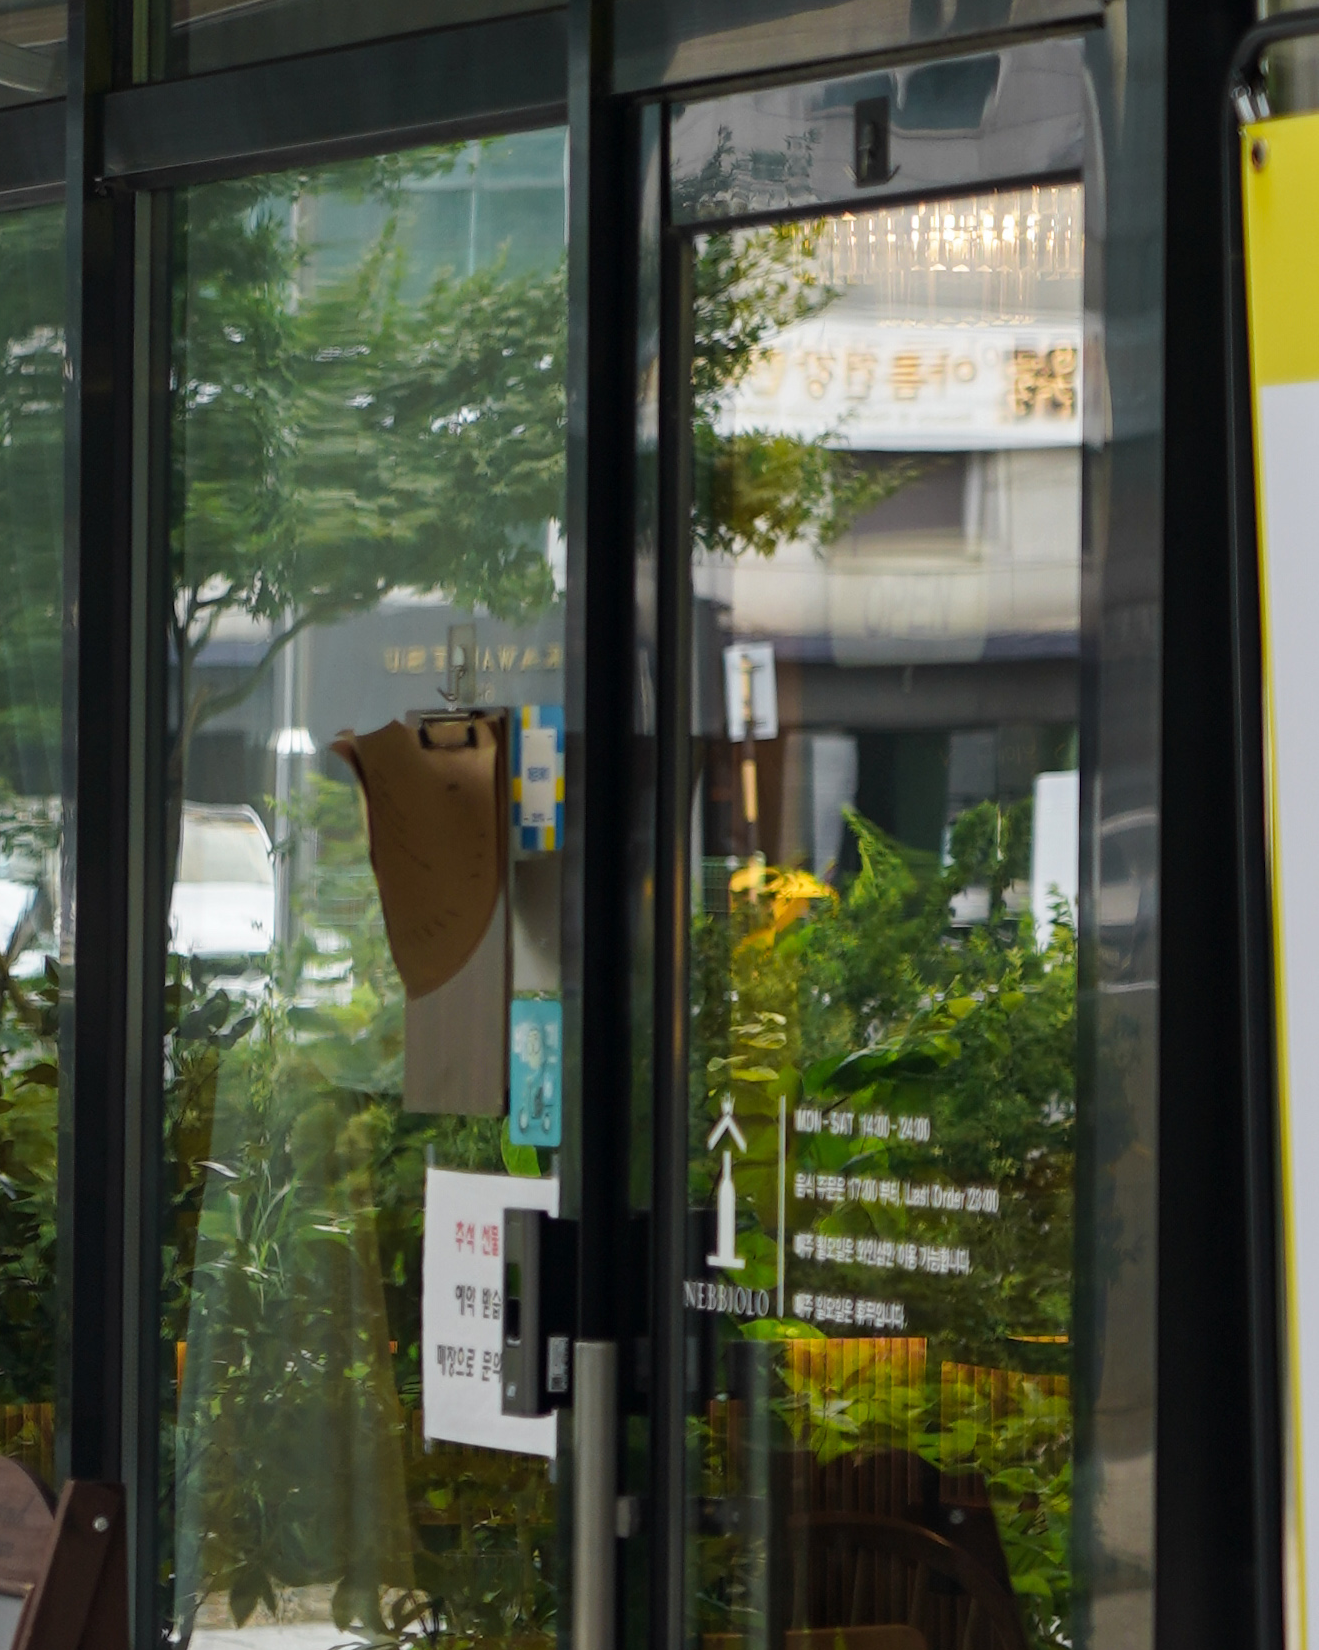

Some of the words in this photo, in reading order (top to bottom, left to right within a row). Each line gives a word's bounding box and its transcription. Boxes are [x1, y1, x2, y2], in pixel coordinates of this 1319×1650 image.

[793, 1108, 822, 1133] MON
[829, 1111, 855, 1136] SAT
[455, 1221, 475, 1253] 추석
[481, 1223, 500, 1257] 선물
[455, 1284, 476, 1318] 예약
[683, 1280, 770, 1318] NEBBIOLO
[436, 1343, 476, 1378] 매장으로
